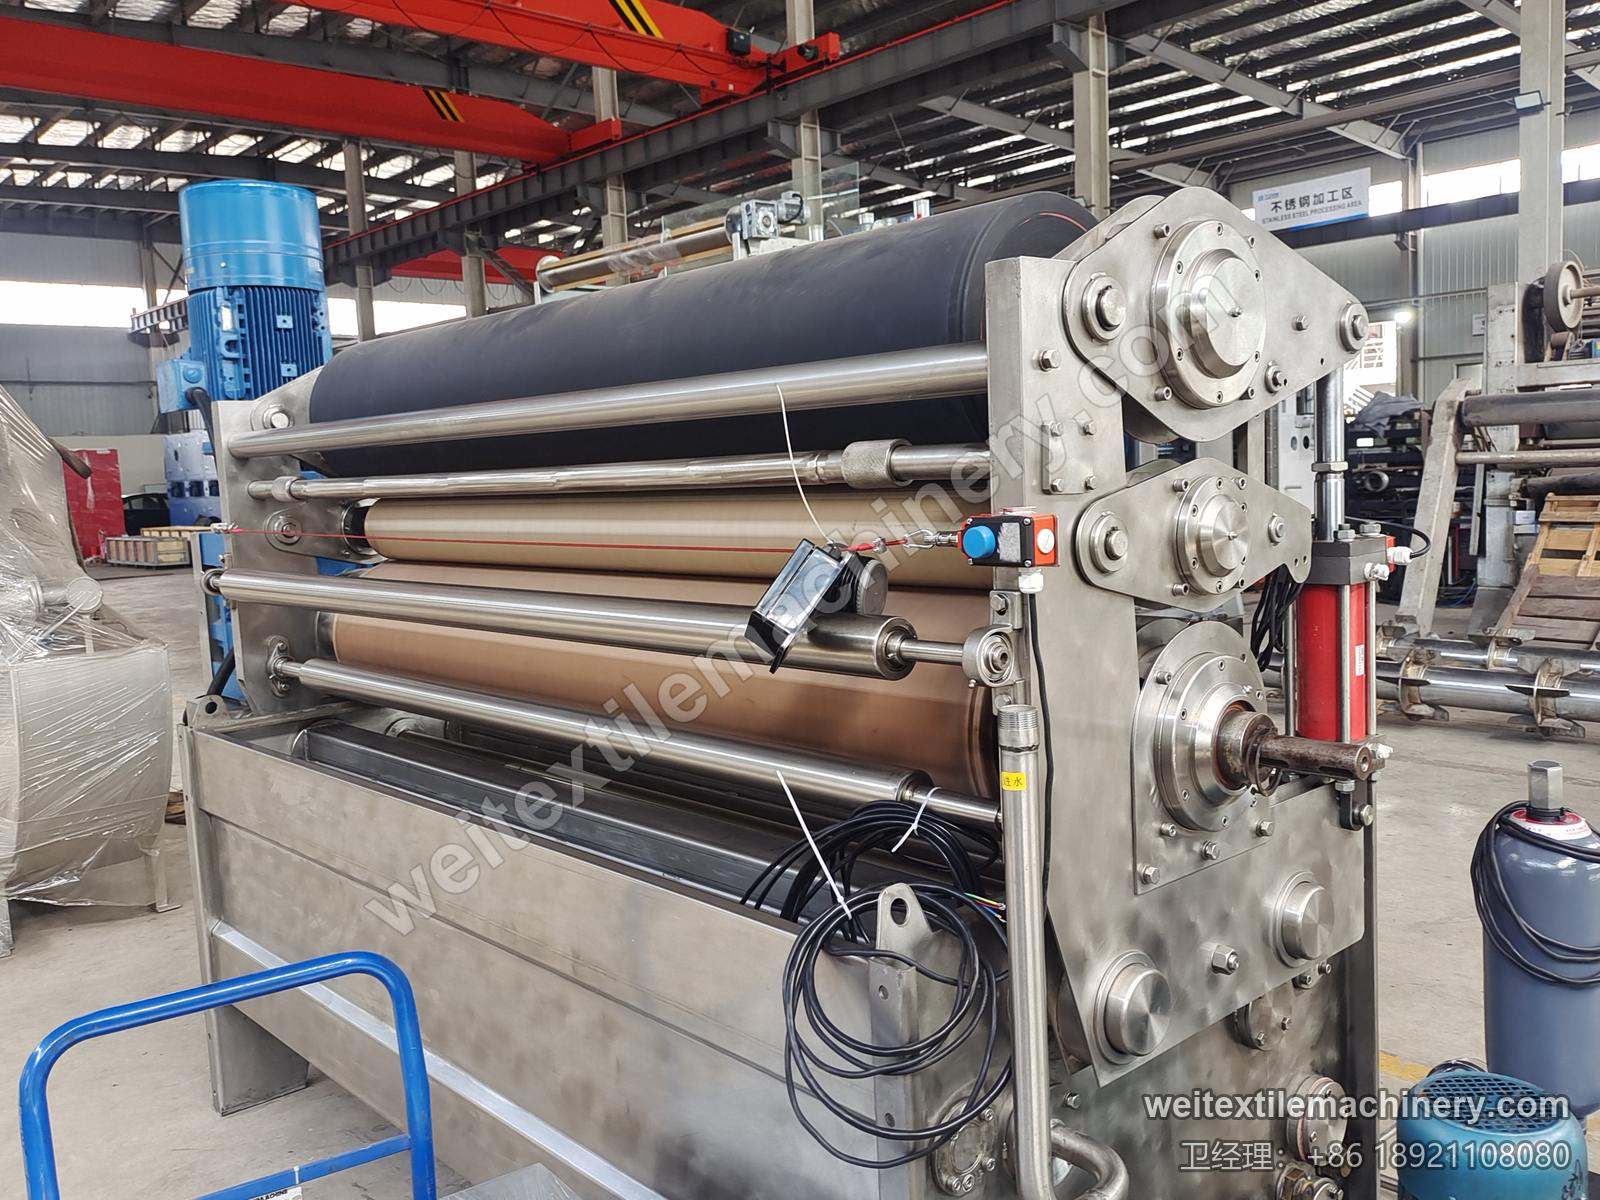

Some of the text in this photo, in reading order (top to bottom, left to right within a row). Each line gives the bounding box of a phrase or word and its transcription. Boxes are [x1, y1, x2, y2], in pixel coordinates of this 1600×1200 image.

[1262, 200, 1362, 224] STAINLESS STEEL PROCESSING AREA
[1271, 186, 1352, 213] 不锈钢加工区
